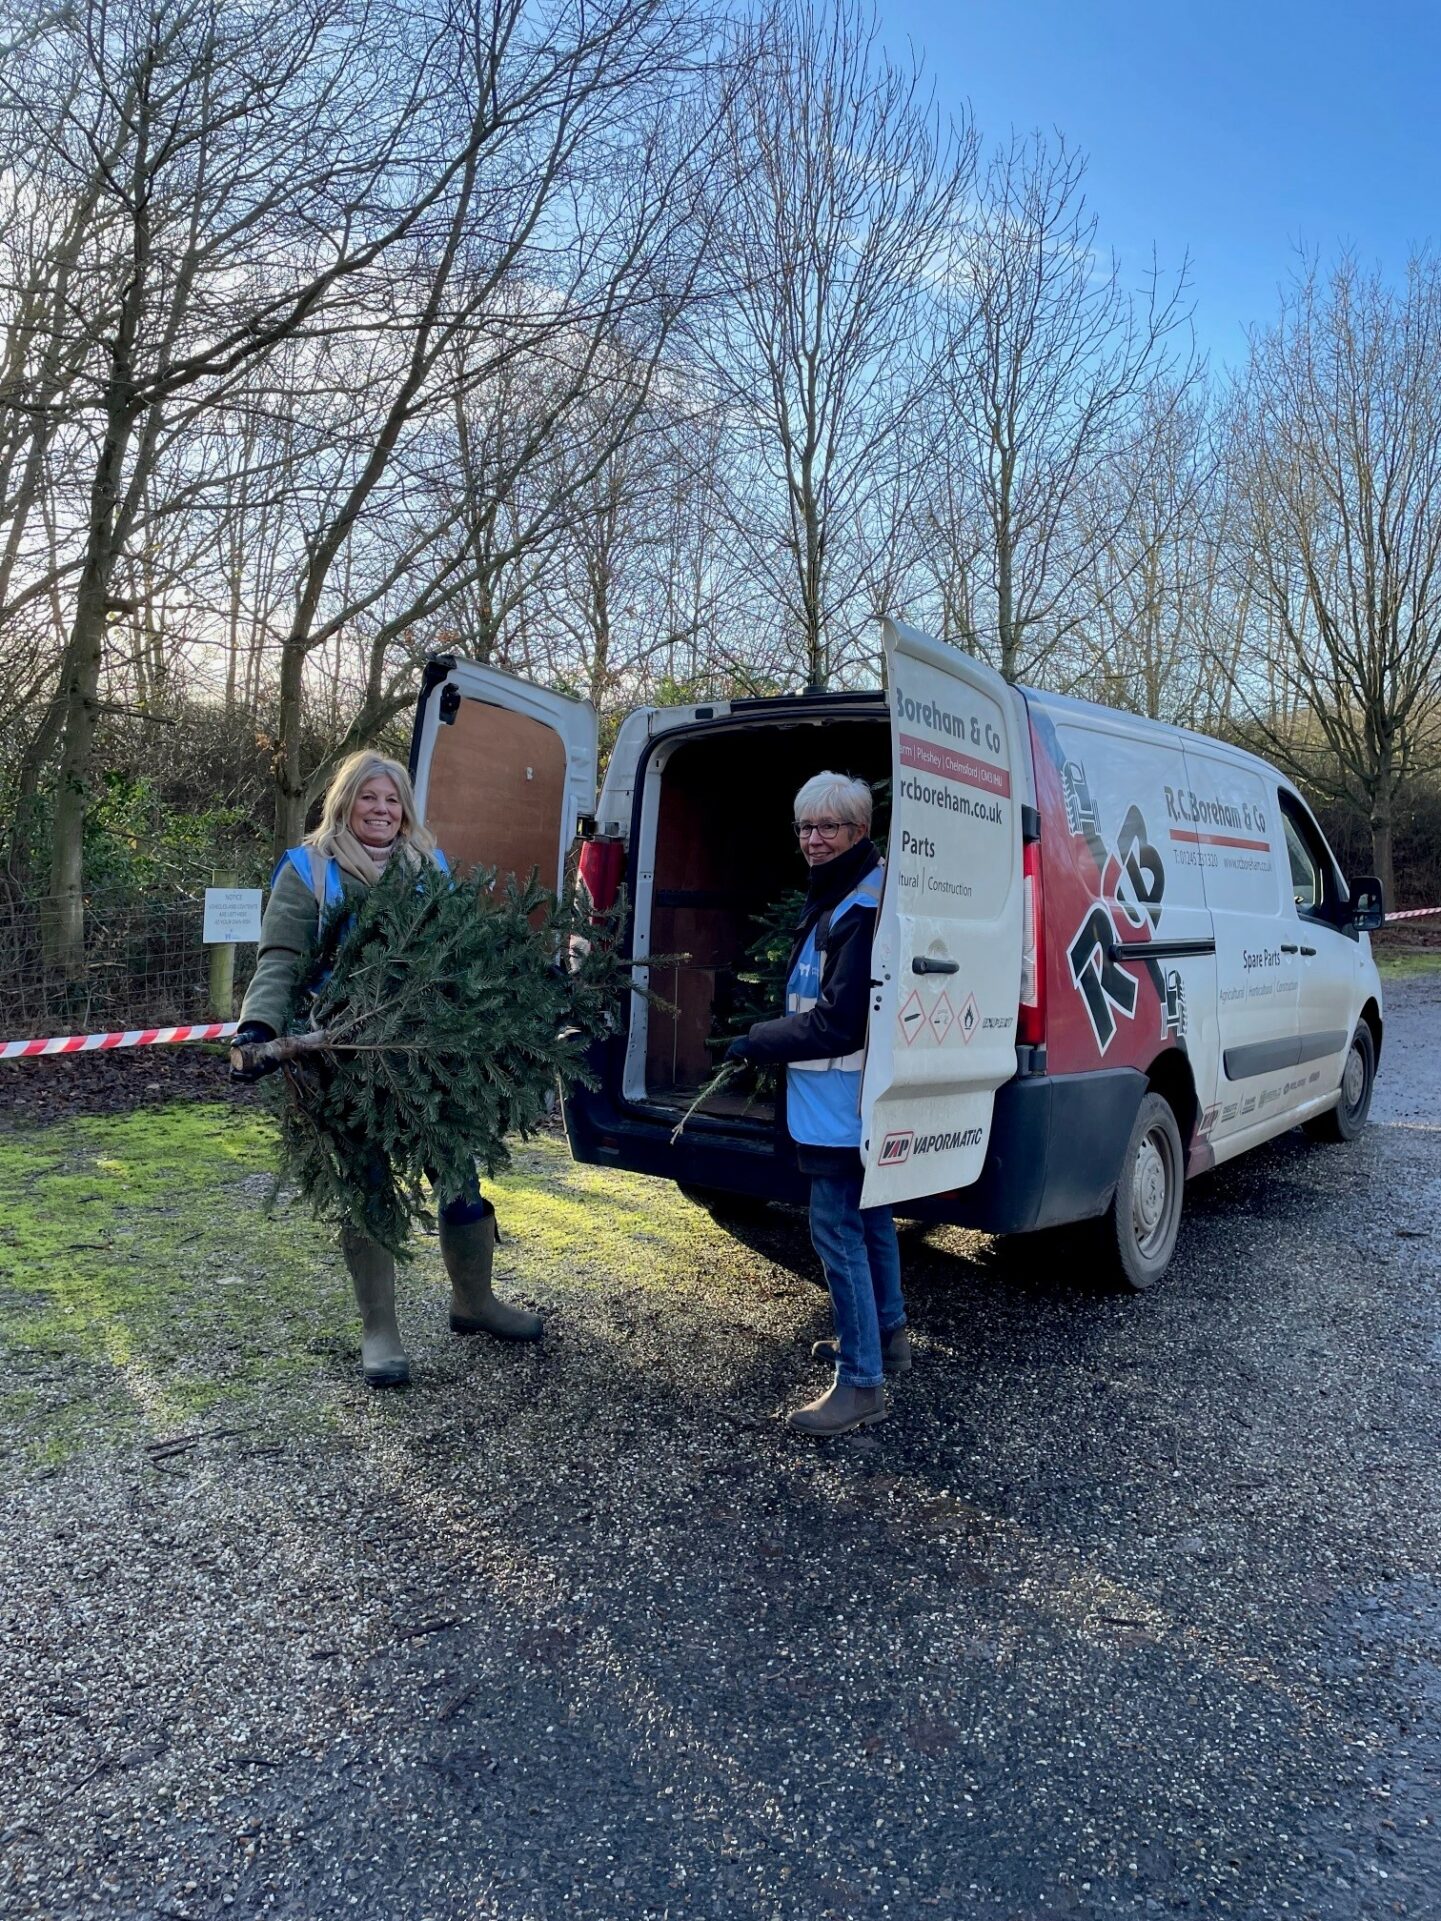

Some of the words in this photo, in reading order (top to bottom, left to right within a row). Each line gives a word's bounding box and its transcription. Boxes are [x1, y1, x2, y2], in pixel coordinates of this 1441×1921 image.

[970, 716, 981, 746] &
[985, 723, 1000, 754] Co
[917, 747, 941, 768] Pleshey
[945, 756, 978, 778] Chelmsford
[900, 776, 1002, 824] rcboreham.co.uk
[1242, 802, 1253, 831] &
[1253, 805, 1266, 833] Co
[902, 830, 935, 858] Parts
[928, 876, 972, 897] Construction
[1243, 949, 1263, 974] Spare
[1264, 948, 1280, 967] Parts
[883, 1139, 909, 1159] VAP
